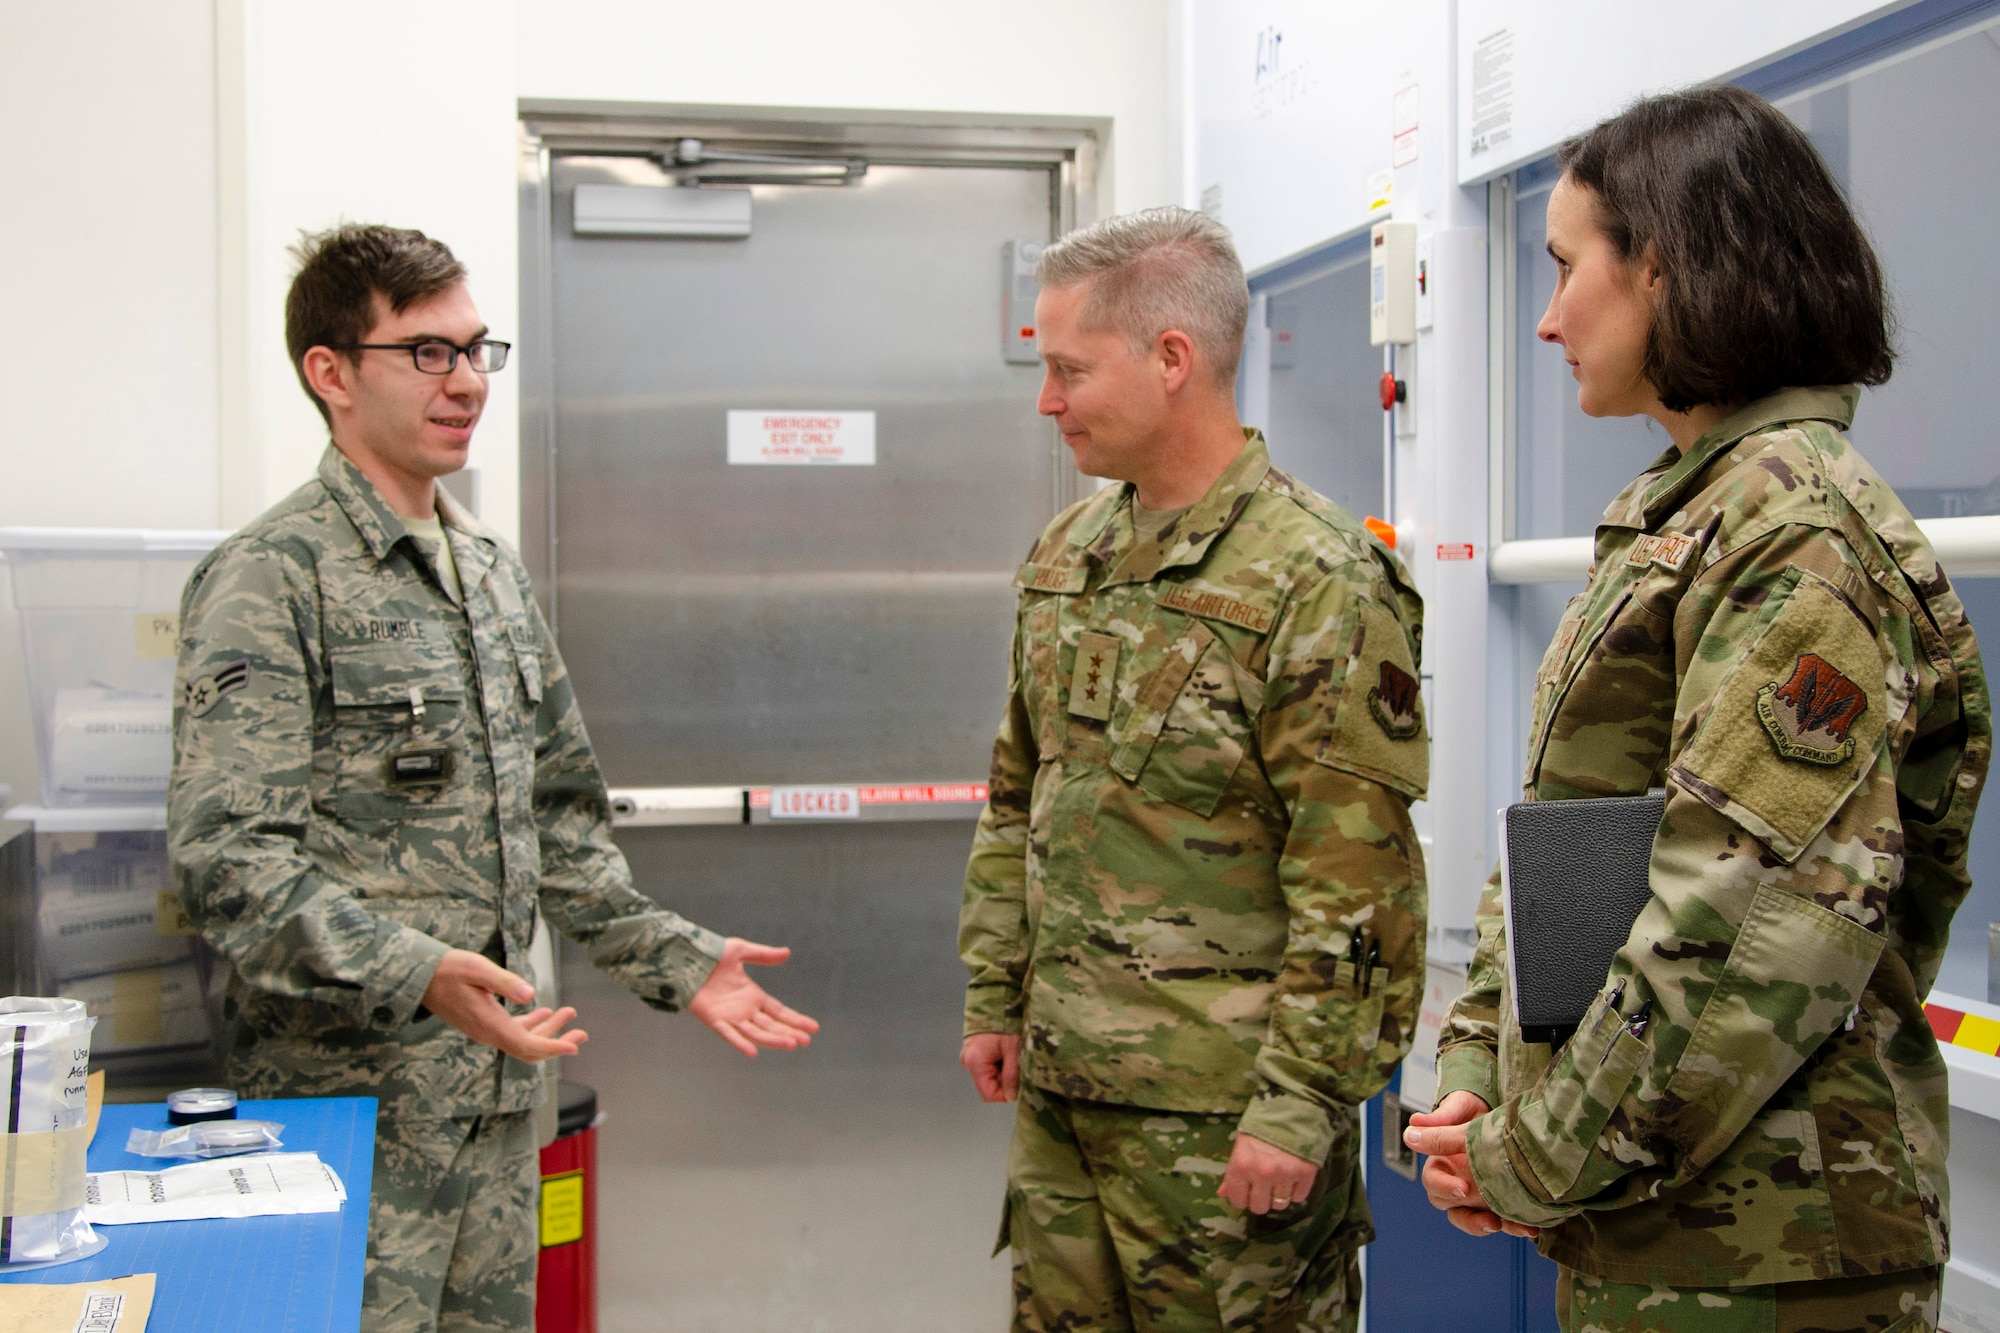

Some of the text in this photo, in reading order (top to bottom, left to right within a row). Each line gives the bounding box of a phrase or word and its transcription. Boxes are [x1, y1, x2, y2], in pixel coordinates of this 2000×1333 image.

[762, 416, 842, 430] EMERGENCY
[771, 431, 835, 445] EXIT ONLY
[1191, 593, 1219, 617] AIR
[1217, 597, 1269, 630] FORCE
[370, 620, 426, 640] RUMBLE
[1760, 703, 1773, 720] AIR
[1792, 746, 1839, 762] COMMAND
[780, 790, 851, 814] LOCKED
[860, 785, 973, 801] ALARM WILL SOUND
